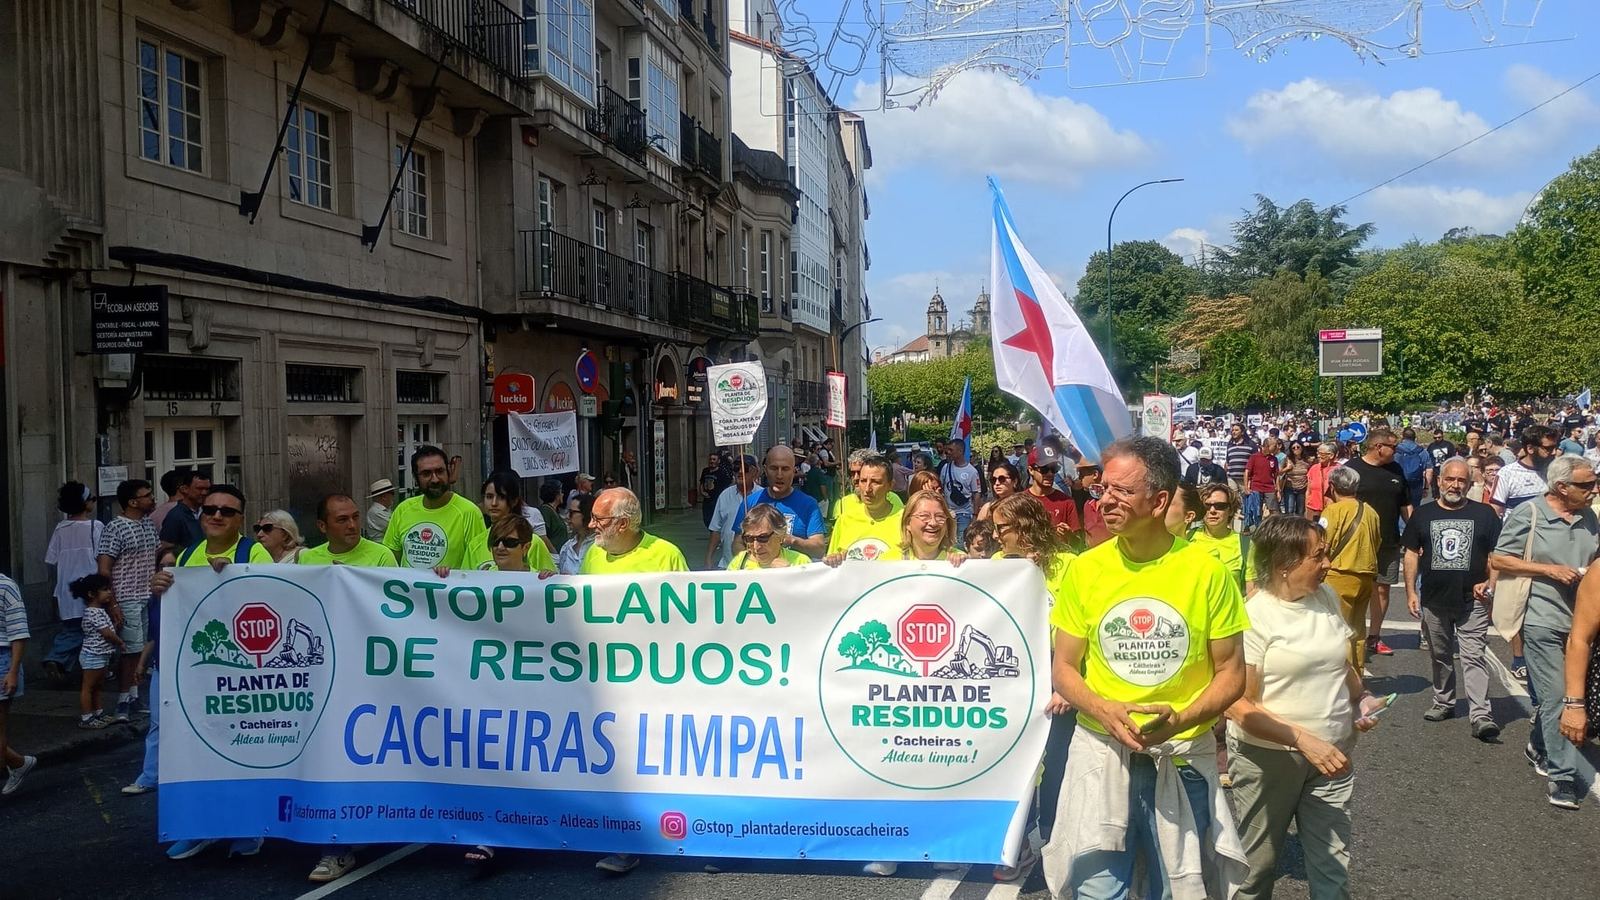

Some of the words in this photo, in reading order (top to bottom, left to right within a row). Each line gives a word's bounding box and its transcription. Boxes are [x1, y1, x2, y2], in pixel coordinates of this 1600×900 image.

[107, 303, 132, 313] ECOBLAN
[133, 302, 159, 312] ASESORES
[500, 394, 527, 403] luckia
[556, 397, 573, 409] luckia
[722, 396, 755, 404] RESIDUOS
[166, 402, 178, 415] 15
[210, 402, 221, 416] 17
[408, 550, 440, 558] RESIDUOS
[380, 579, 525, 623] STOP
[544, 581, 776, 624] PLANTA
[1133, 616, 1152, 625] STOP
[240, 618, 274, 639] STOP
[906, 622, 948, 644] STOP
[1118, 641, 1155, 650] PLANTA
[1158, 640, 1171, 649] DE
[365, 635, 438, 678] DE
[469, 639, 791, 686] RESIDUOS!
[1114, 649, 1179, 660] RESIDUOS
[217, 673, 285, 692] PLANTA
[292, 672, 310, 688] DE
[868, 684, 957, 702] PLANTA
[963, 685, 991, 703] DE
[205, 691, 314, 715] RESIDUOS
[240, 719, 292, 730] Cacheiras
[852, 705, 1008, 729] RESIDUOS
[230, 731, 265, 746] Aldeas
[344, 704, 616, 774] CACHEIRAS
[636, 713, 804, 780] LIMPA!
[894, 735, 961, 747] Cacheiras
[880, 748, 924, 764] Aldeas
[340, 805, 373, 819] STOP
[377, 805, 416, 819] Planta
[419, 805, 433, 819] de
[438, 807, 484, 822] residuos
[495, 809, 549, 826] Cacheiras
[560, 813, 599, 829] Aldeas
[603, 815, 641, 833] limpas
[692, 819, 910, 838] @stop_plantaderesiduoscacheiras
